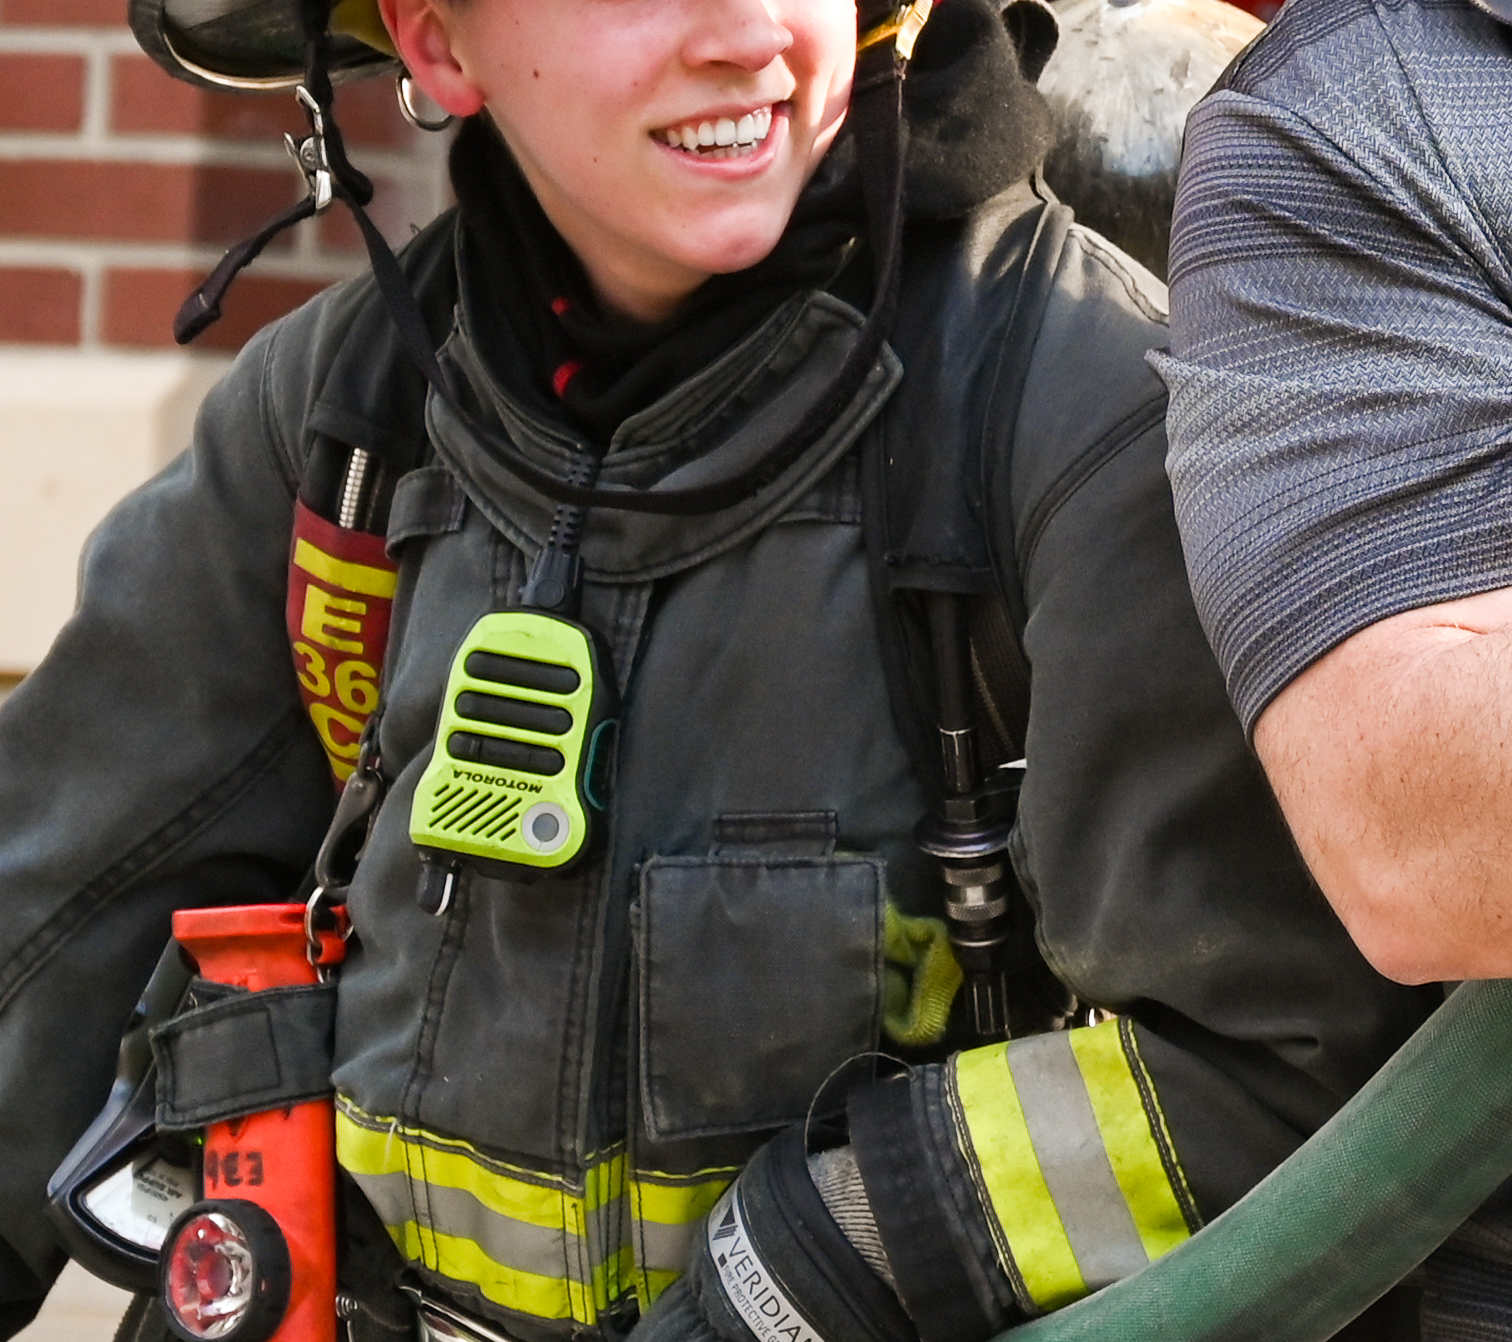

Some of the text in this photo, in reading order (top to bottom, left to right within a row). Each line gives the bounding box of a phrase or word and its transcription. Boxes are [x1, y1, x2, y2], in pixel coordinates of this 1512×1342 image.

[301, 583, 367, 655] E
[293, 641, 380, 715] 36
[453, 769, 544, 794] MOTOROLA
[722, 1264, 736, 1287] FIRE
[731, 1281, 772, 1339] PROTECTIVE
